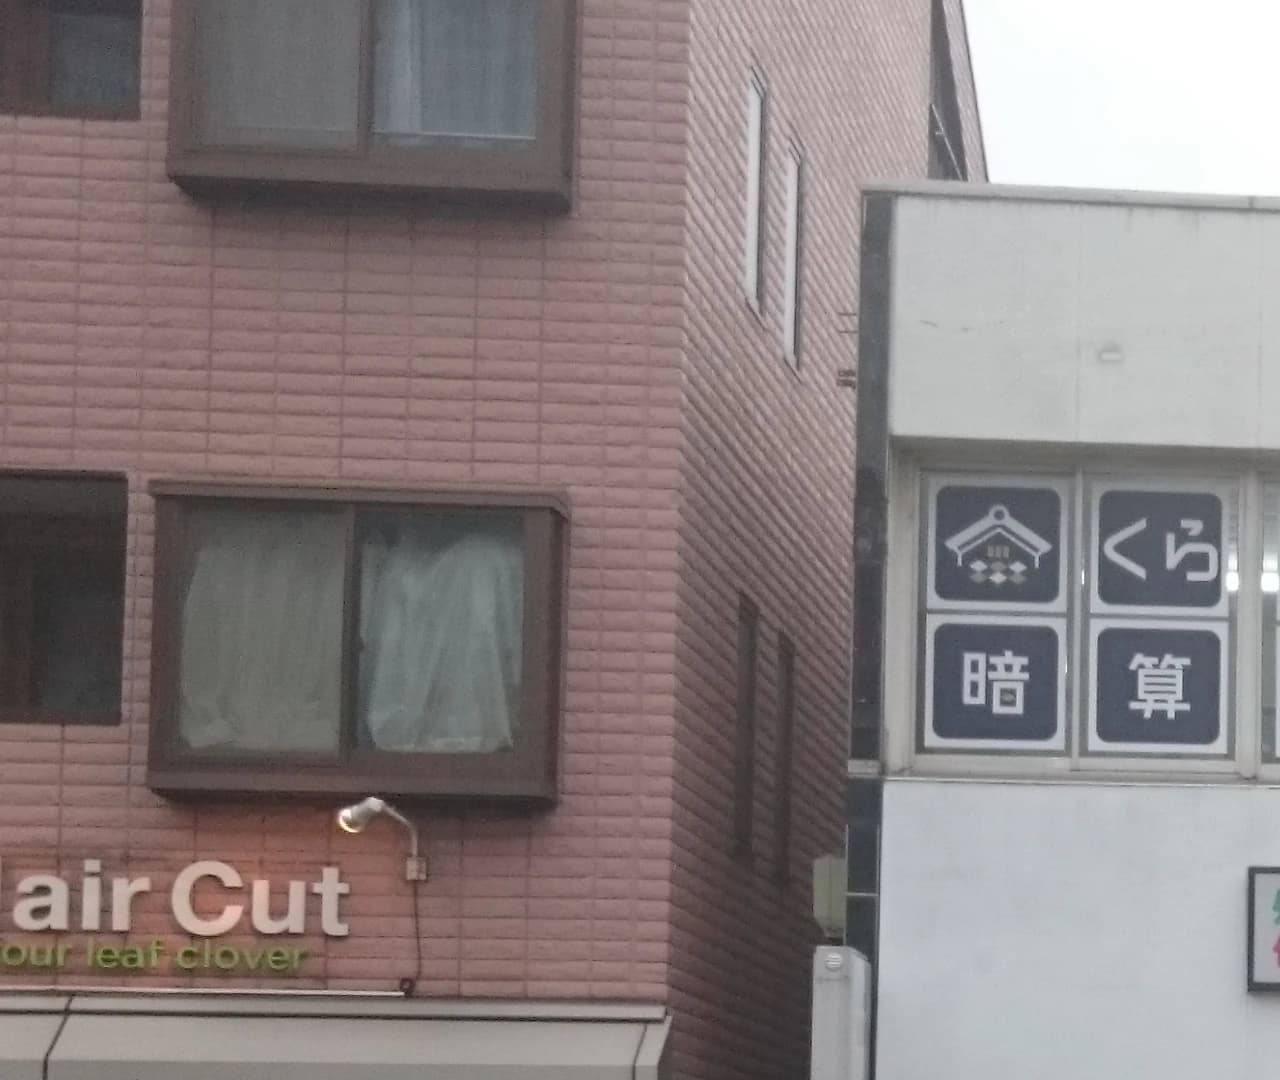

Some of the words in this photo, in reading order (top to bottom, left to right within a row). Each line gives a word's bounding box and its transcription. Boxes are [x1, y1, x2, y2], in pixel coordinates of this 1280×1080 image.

[12, 859, 151, 932] air
[171, 859, 350, 937] Cut
[87, 938, 164, 969] leaf
[176, 938, 306, 971] clover
